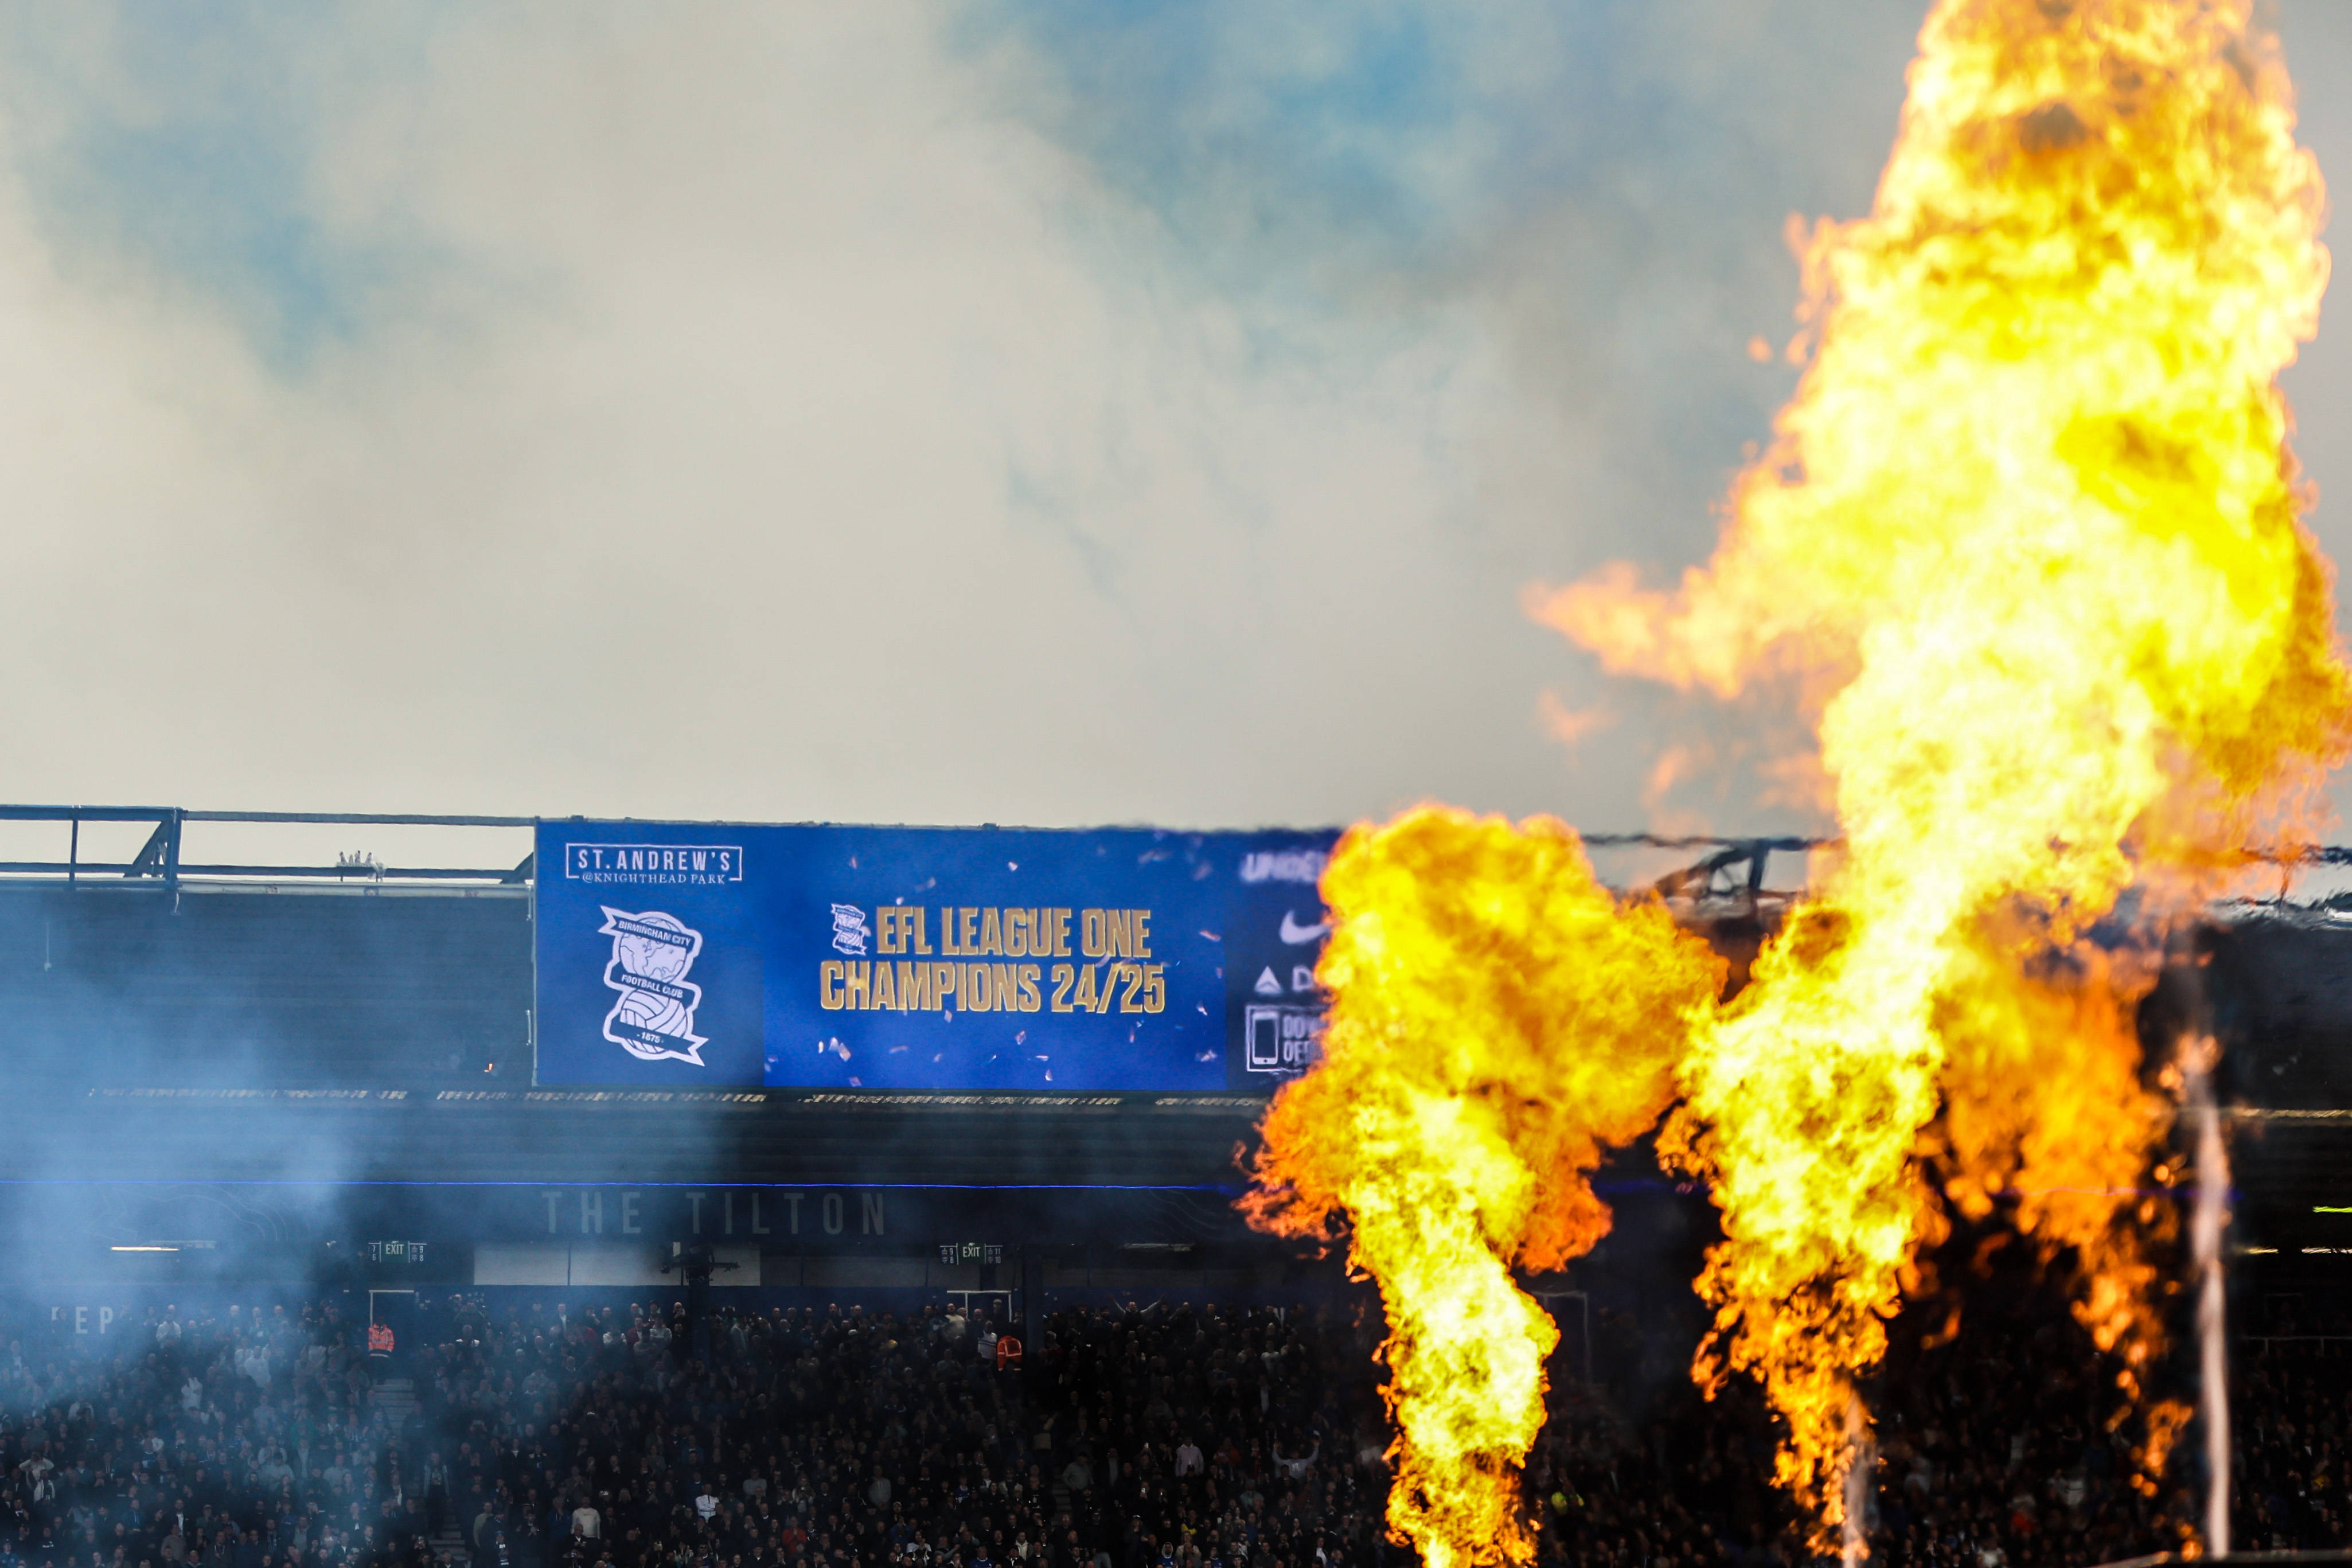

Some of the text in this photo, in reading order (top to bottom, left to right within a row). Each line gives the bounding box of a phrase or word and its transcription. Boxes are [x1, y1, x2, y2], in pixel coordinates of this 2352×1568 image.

[583, 872, 726, 884] @KNIGHTHEAD PARK
[618, 920, 692, 946] BIRMINGHAM CITY
[876, 906, 1151, 958] EFL LEAGUE ONE
[621, 974, 684, 998] FOOTBALL CLUB
[820, 960, 1165, 1015] CHAMPIONS 24/25
[641, 1032, 661, 1044] 1875
[541, 1191, 885, 1236] THE TILTON
[372, 1245, 376, 1253] 7
[385, 1243, 404, 1255] EXIT
[963, 1247, 981, 1257] EXIT
